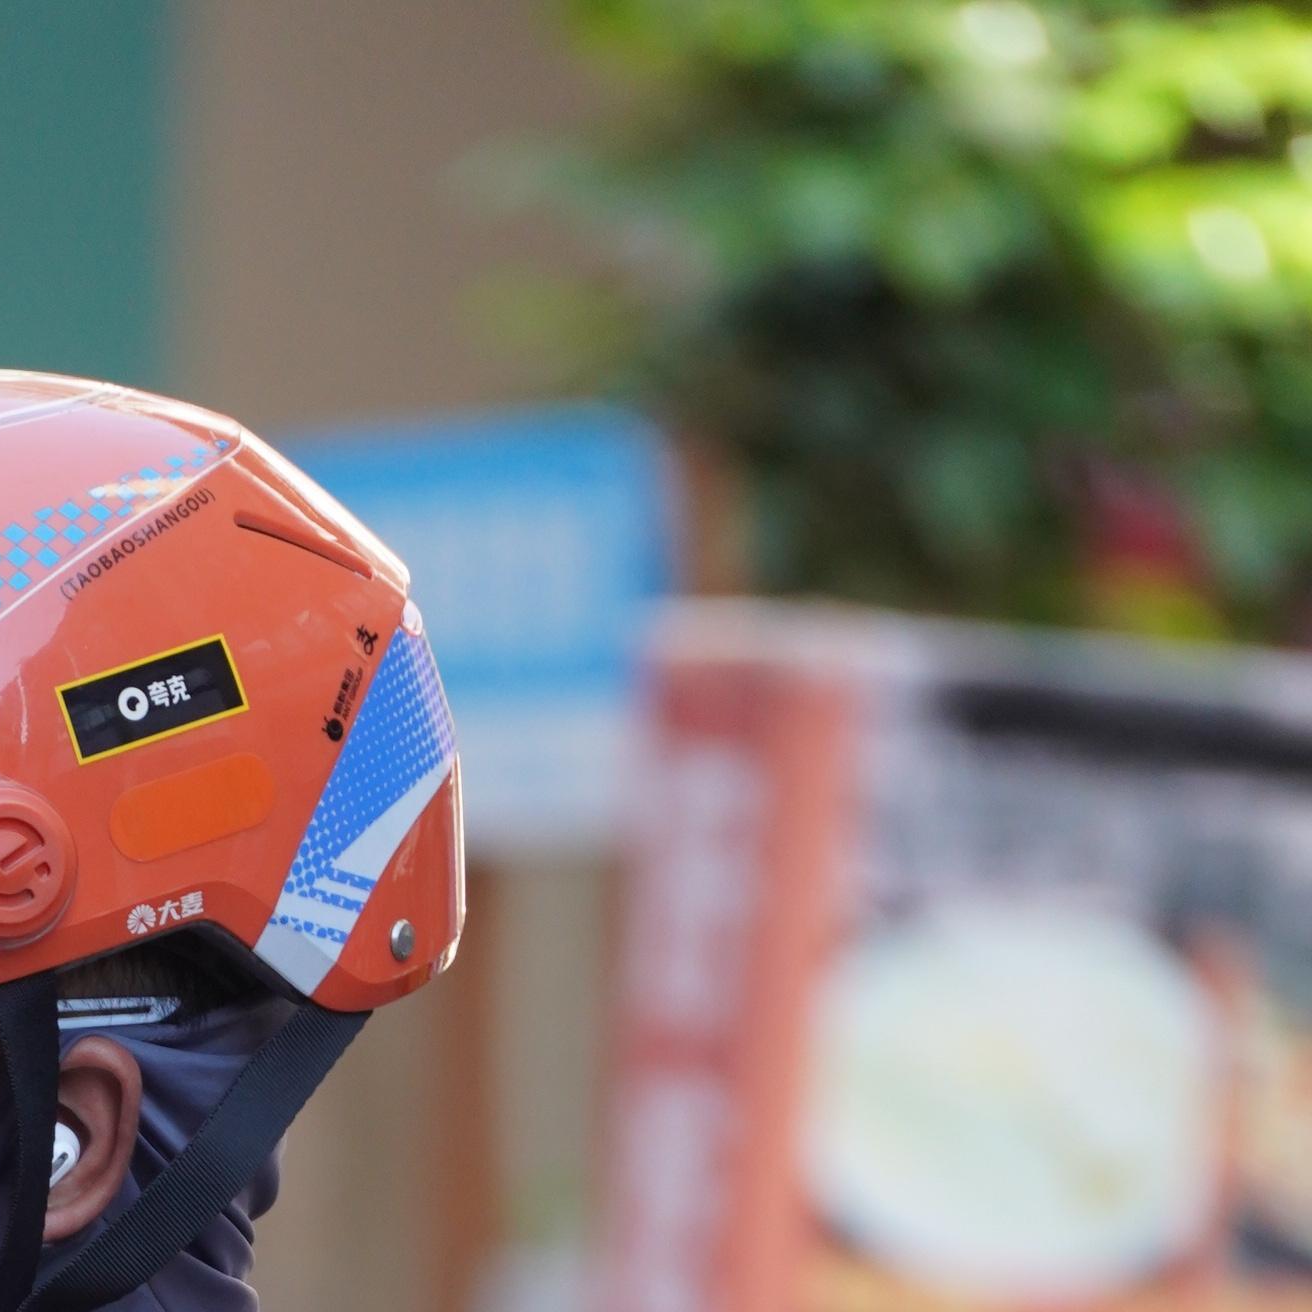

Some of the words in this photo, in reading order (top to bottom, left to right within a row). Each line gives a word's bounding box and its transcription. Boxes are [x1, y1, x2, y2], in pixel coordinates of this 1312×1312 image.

[60, 488, 216, 600] (TAOBAOSHANGOU)
[147, 675, 191, 708] 夸克
[158, 891, 204, 925] 大麦
